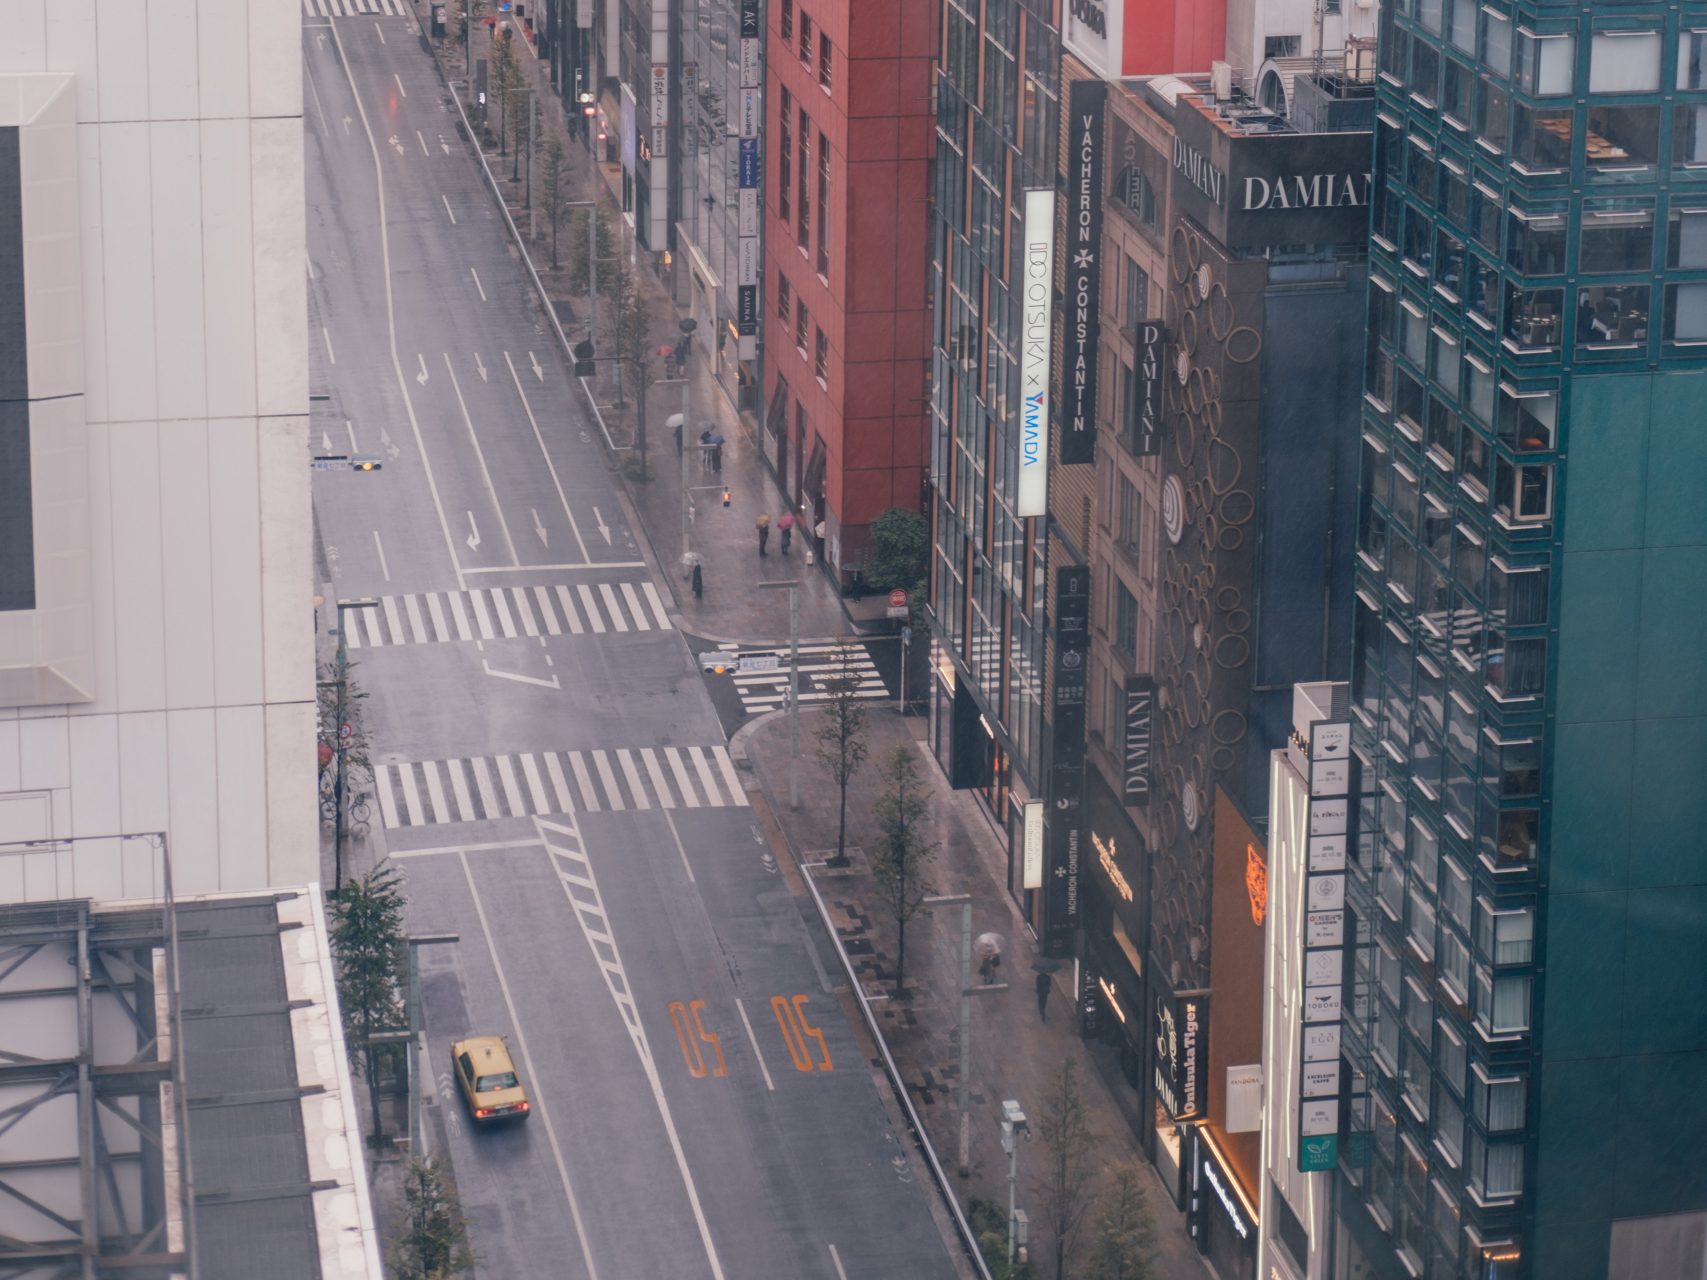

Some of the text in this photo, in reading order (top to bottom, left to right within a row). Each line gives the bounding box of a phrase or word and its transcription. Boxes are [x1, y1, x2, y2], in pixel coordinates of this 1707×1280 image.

[1173, 135, 1221, 206] DAMIANI
[743, 290, 752, 321] SAUNA
[1074, 115, 1092, 432] VACHERON CONSTANTIN
[1027, 283, 1046, 369] OTSUKA
[1024, 391, 1044, 466] YAMADA
[1142, 326, 1158, 452] DAMIANI
[1126, 691, 1151, 793] DAMIANI
[1068, 829, 1078, 915] VACHERON CONSTANTIN
